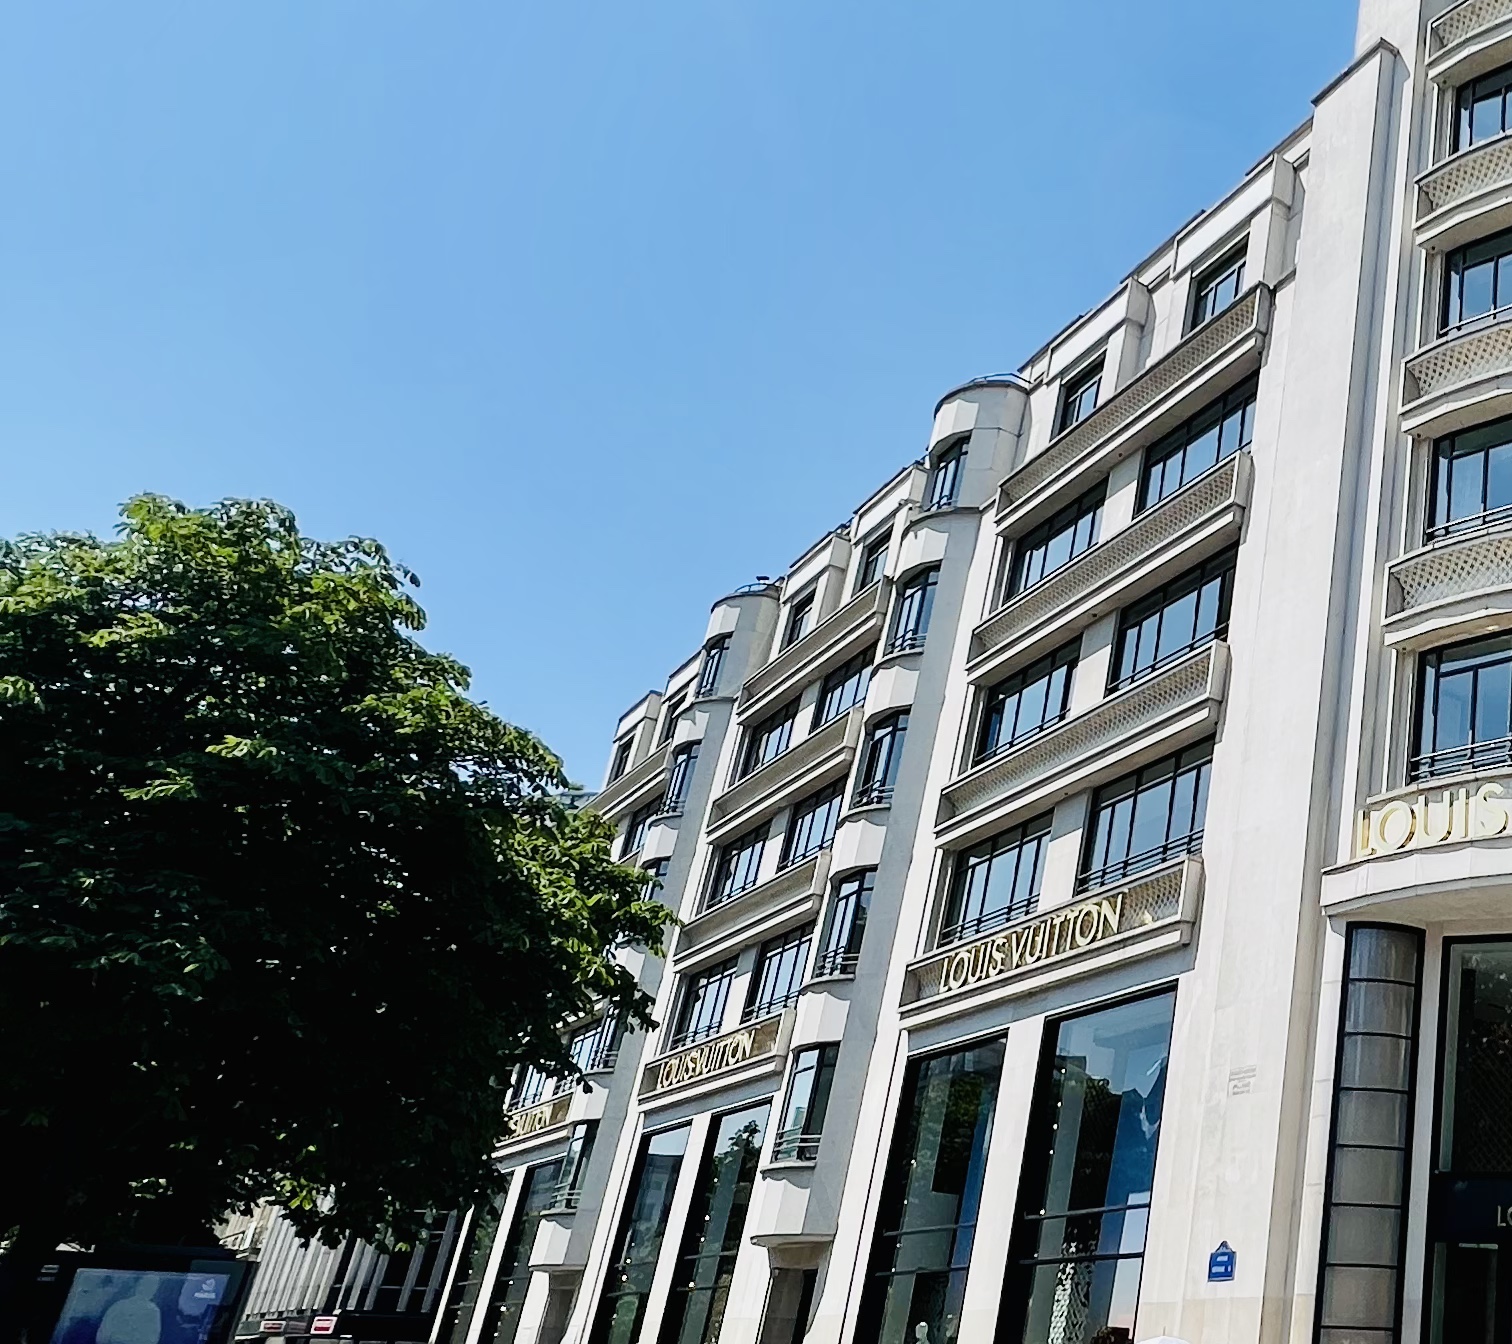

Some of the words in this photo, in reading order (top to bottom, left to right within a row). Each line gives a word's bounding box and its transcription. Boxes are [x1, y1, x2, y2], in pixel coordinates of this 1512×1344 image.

[1356, 782, 1508, 858] LOUIS
[938, 937, 1009, 994] LOUIS
[1011, 893, 1123, 970] VUITTON
[656, 1051, 699, 1091] LOUIS
[696, 1029, 756, 1077] VUITTON
